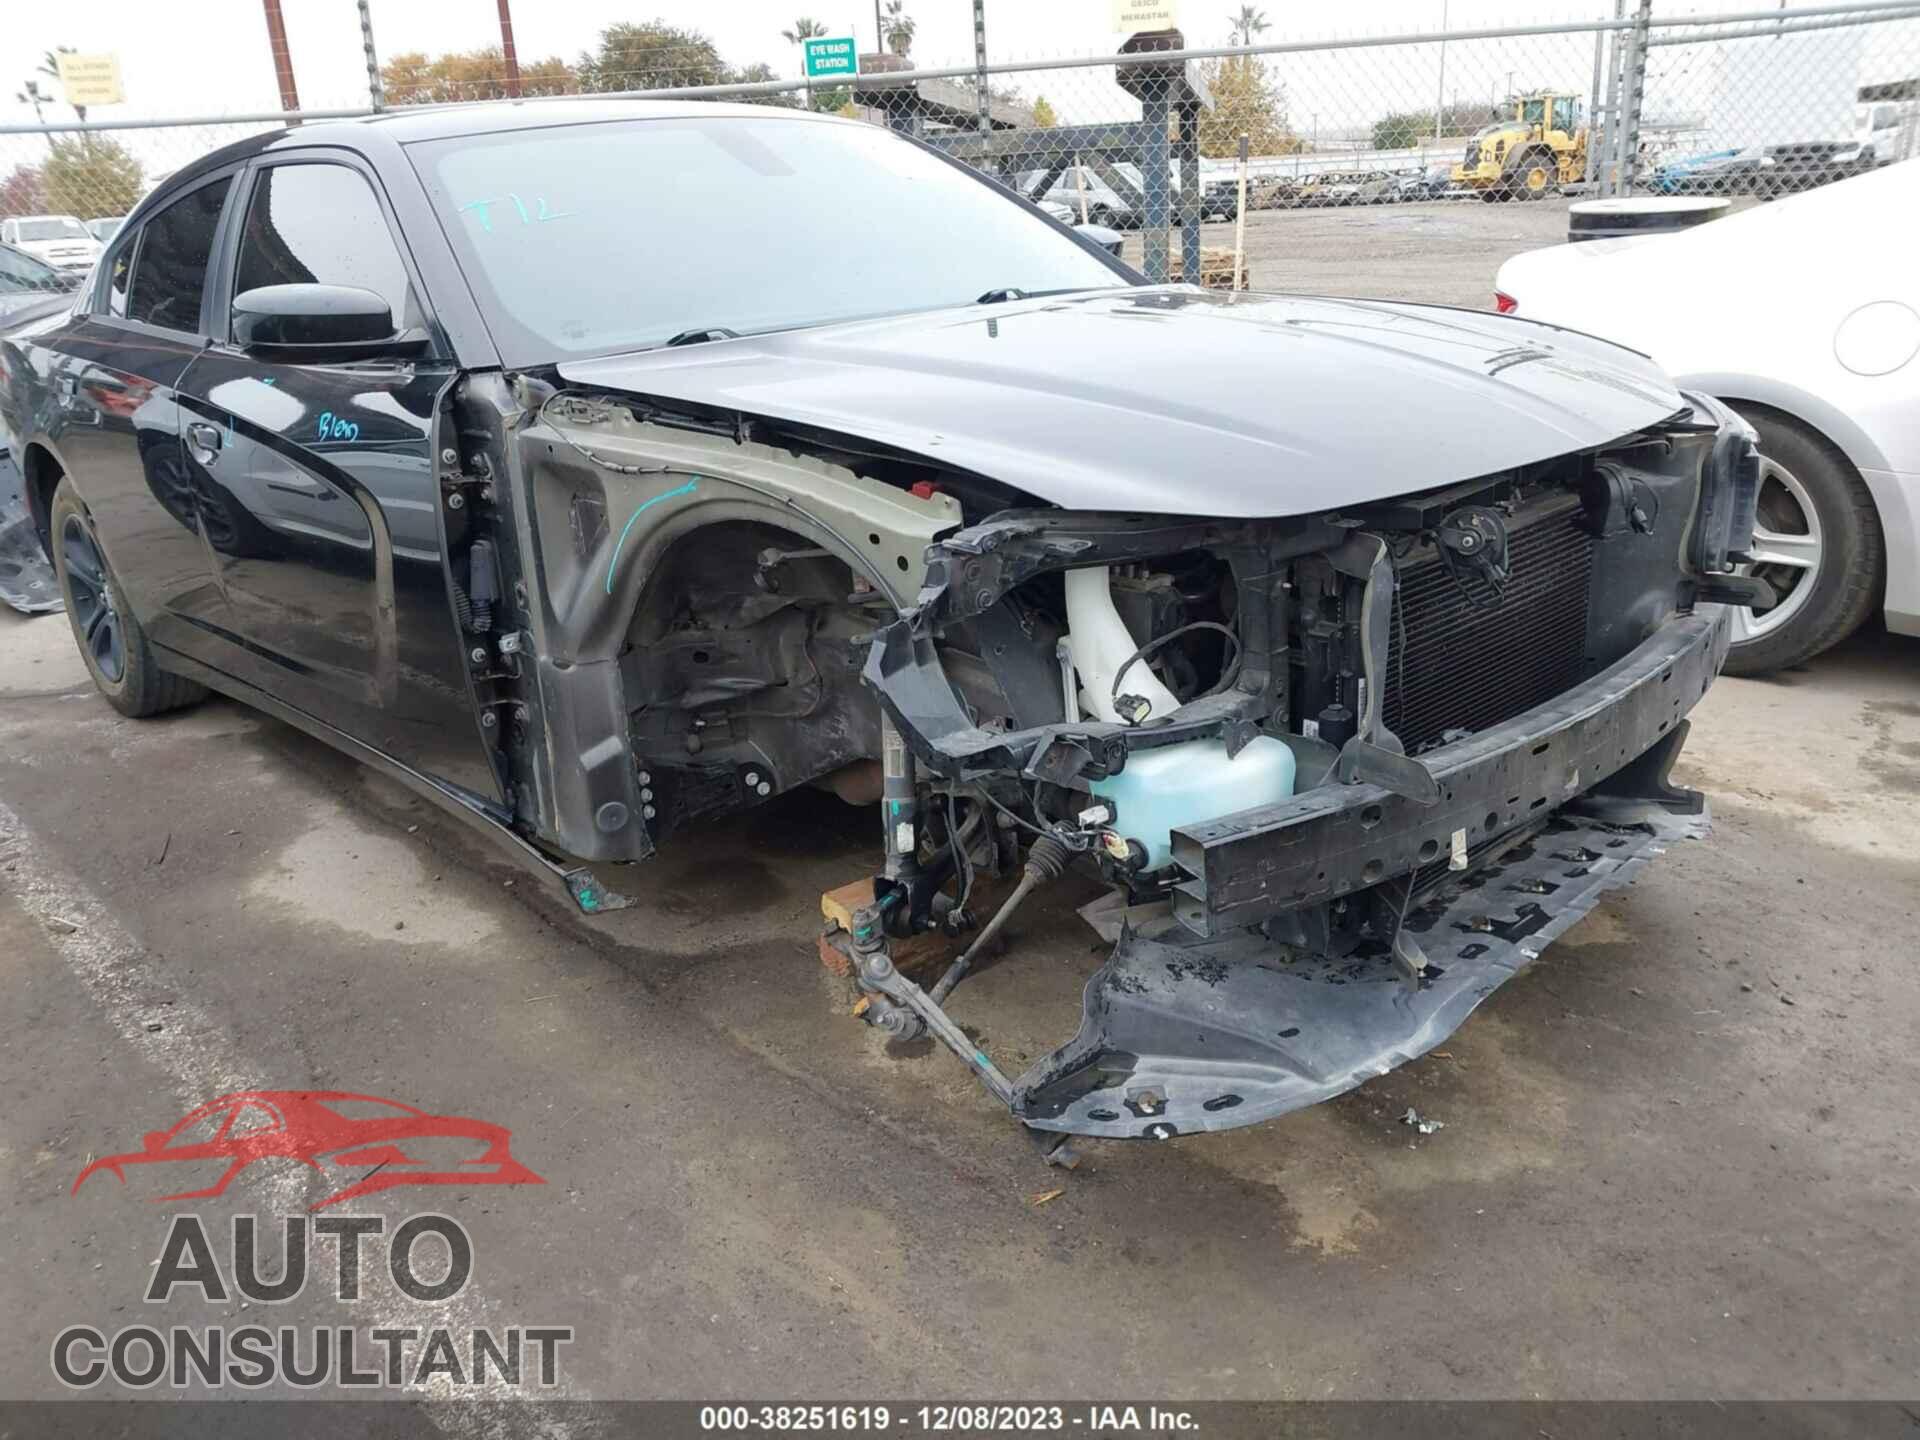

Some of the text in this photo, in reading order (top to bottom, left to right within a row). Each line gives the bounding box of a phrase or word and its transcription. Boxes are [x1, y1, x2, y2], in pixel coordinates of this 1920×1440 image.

[810, 43, 849, 56] EYE WASH
[815, 58, 848, 69] STATION
